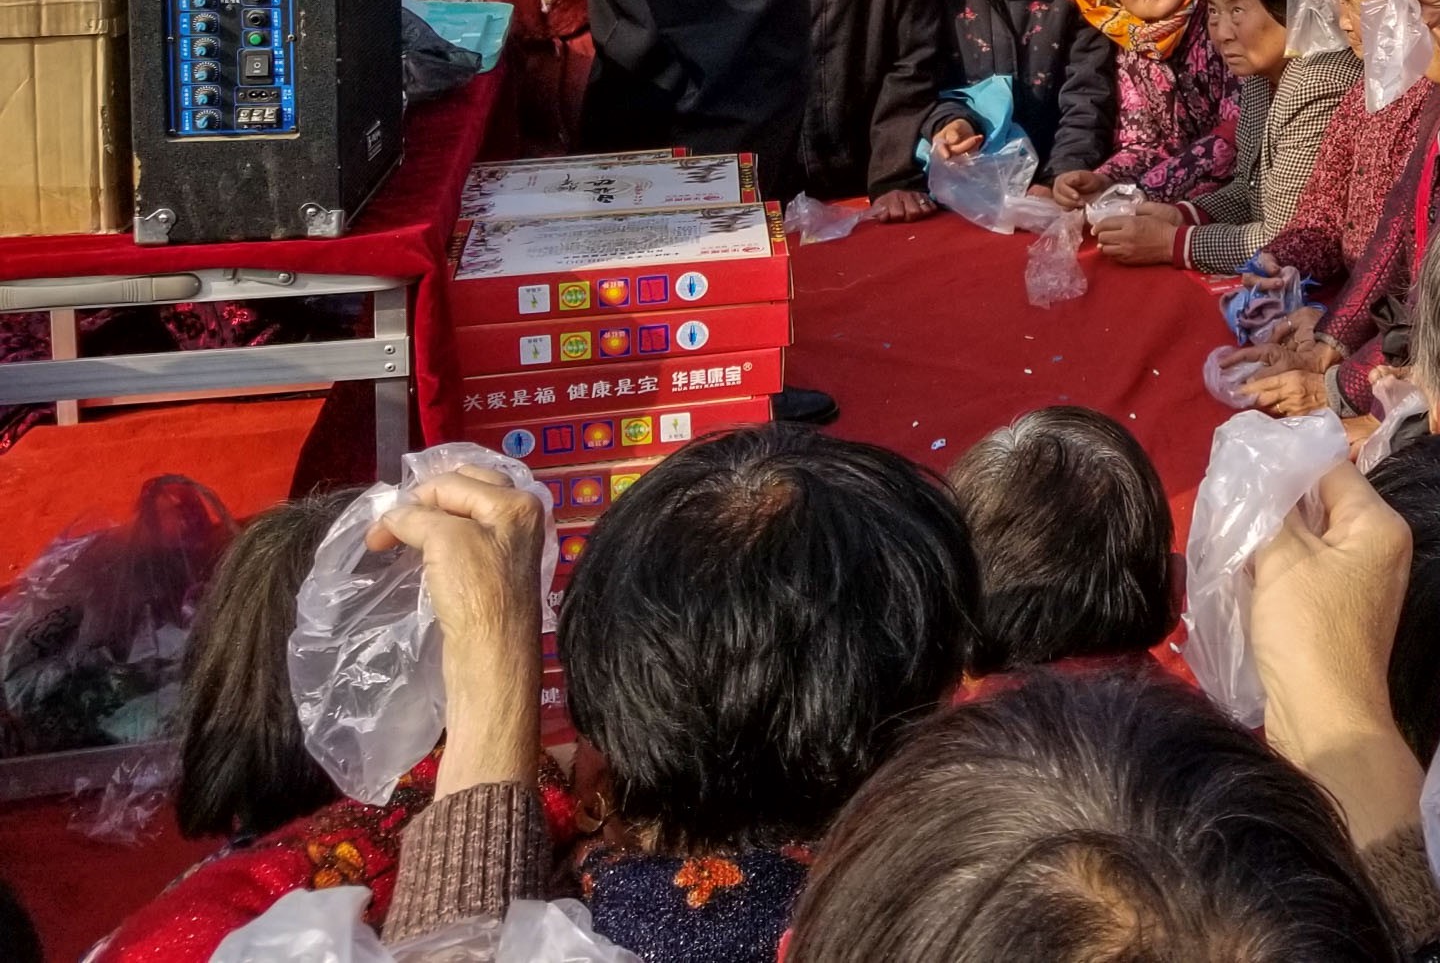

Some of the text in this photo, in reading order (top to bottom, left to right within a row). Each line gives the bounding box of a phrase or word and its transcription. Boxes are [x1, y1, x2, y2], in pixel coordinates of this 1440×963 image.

[463, 365, 742, 412] 关爱是福 健康是宝 华美康宝
